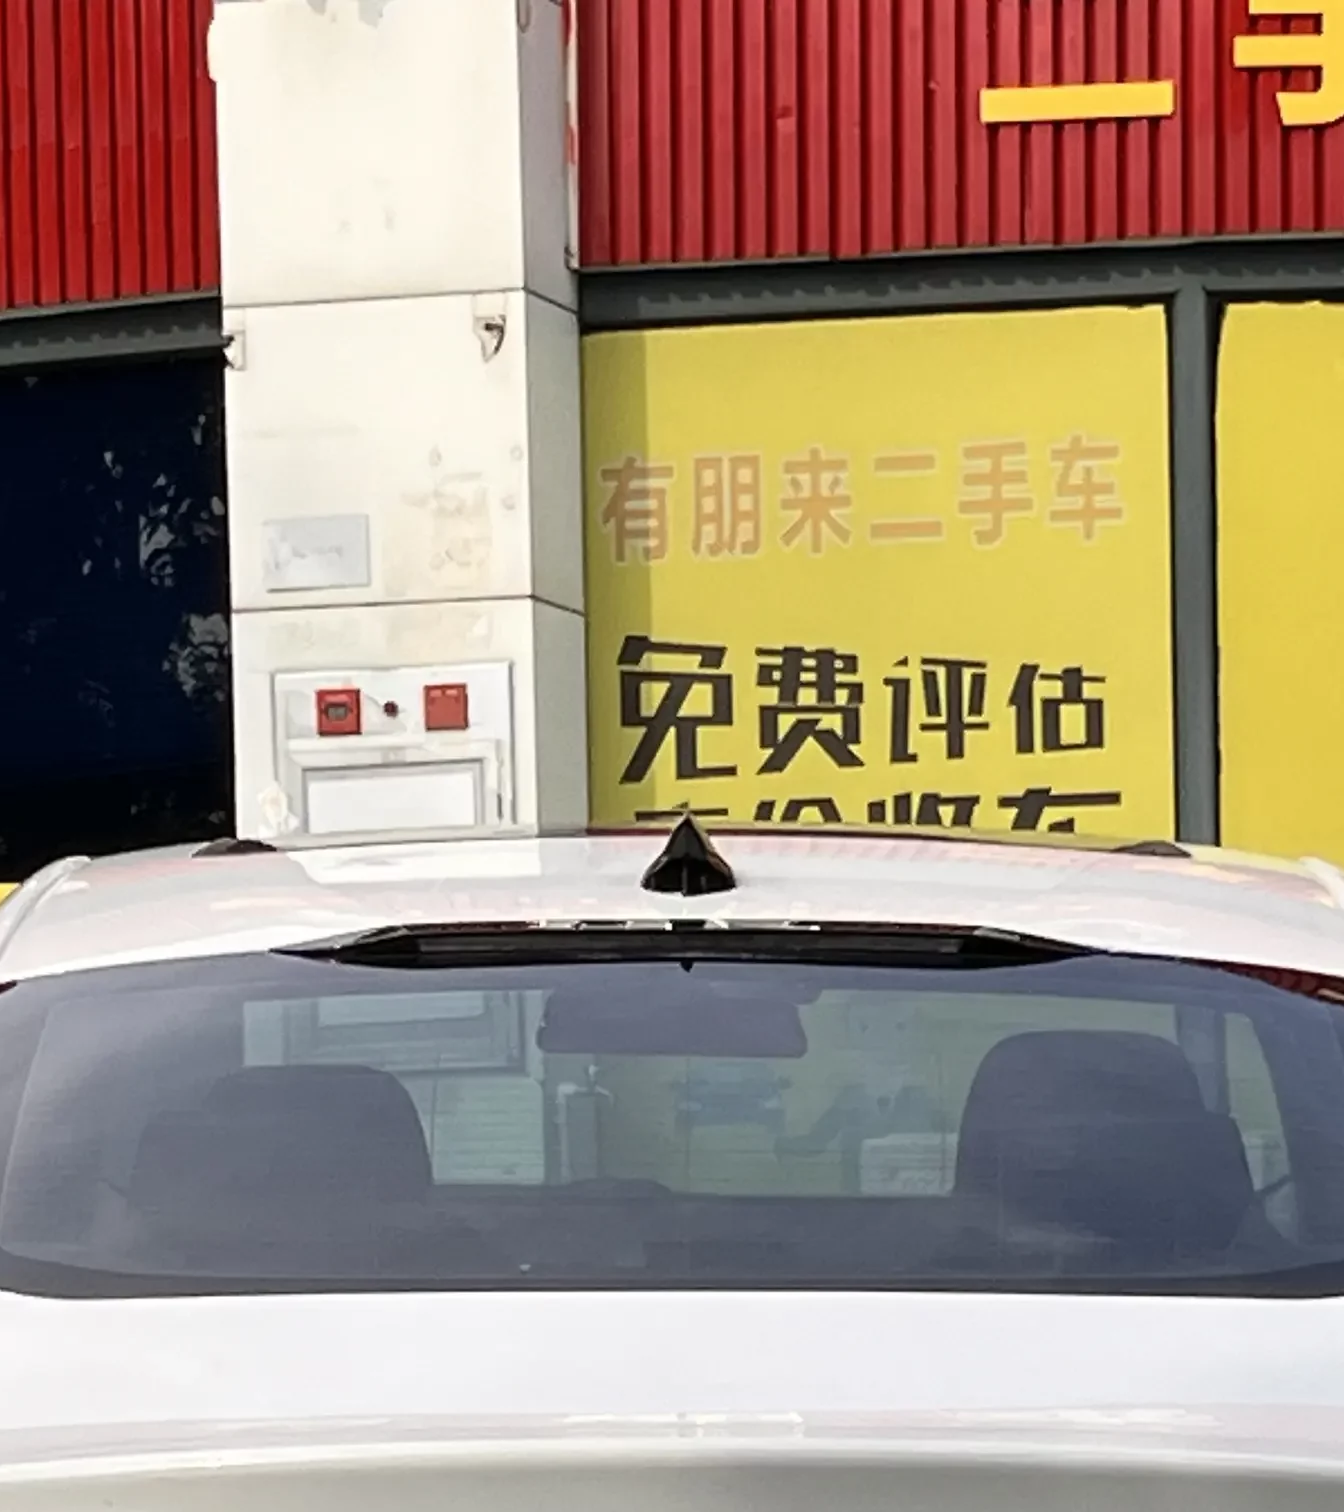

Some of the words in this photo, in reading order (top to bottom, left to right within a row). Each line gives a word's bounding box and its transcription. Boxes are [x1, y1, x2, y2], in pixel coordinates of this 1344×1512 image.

[599, 433, 1124, 564] 有朋来二手车
[616, 635, 1107, 786] 免费评估
